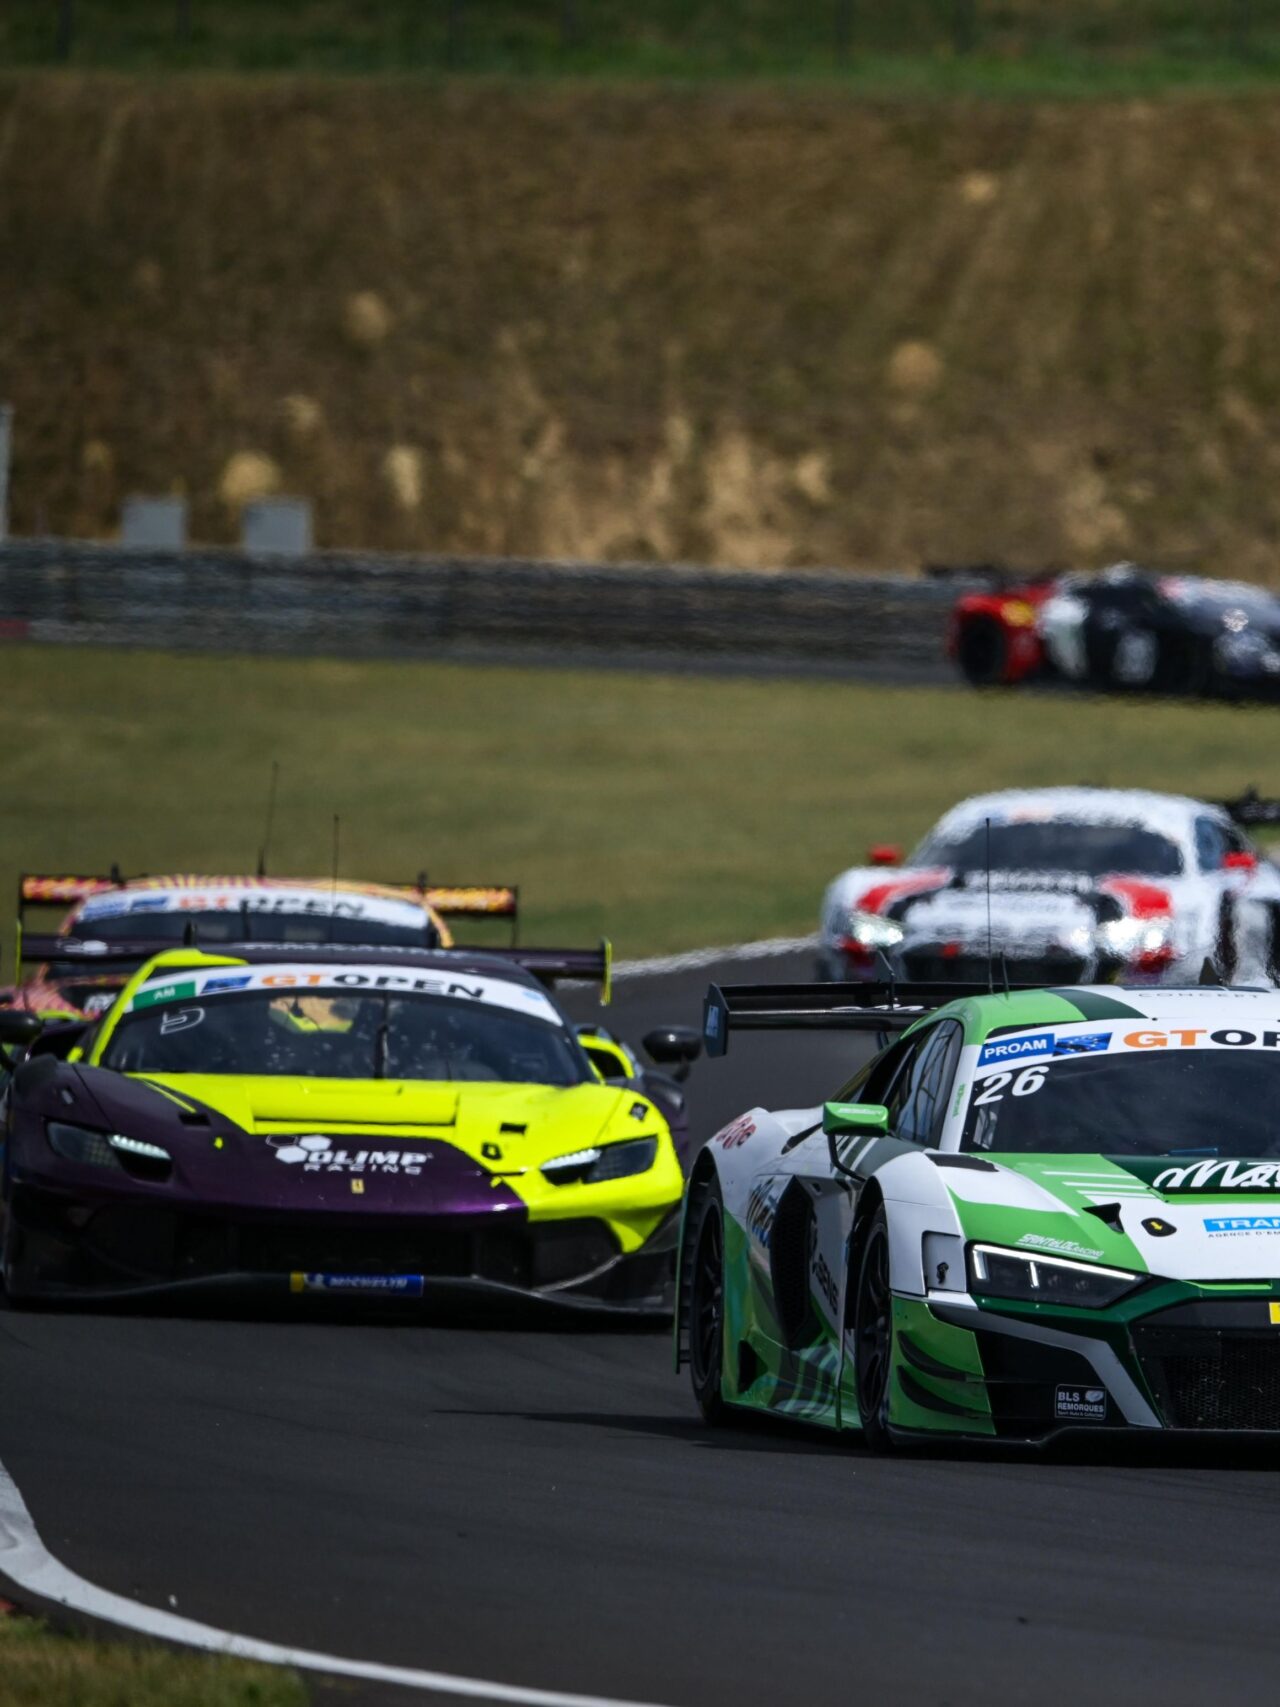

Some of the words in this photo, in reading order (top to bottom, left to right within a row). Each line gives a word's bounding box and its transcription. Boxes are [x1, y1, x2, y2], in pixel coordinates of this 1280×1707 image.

[153, 986, 176, 1000] AM
[985, 1039, 1047, 1059] PROAM
[974, 1065, 1050, 1106] 26
[308, 1150, 428, 1166] OLIMP
[304, 1164, 422, 1175] RACING
[1058, 1391, 1080, 1402] BLS
[1057, 1402, 1104, 1413] REMORQUES
